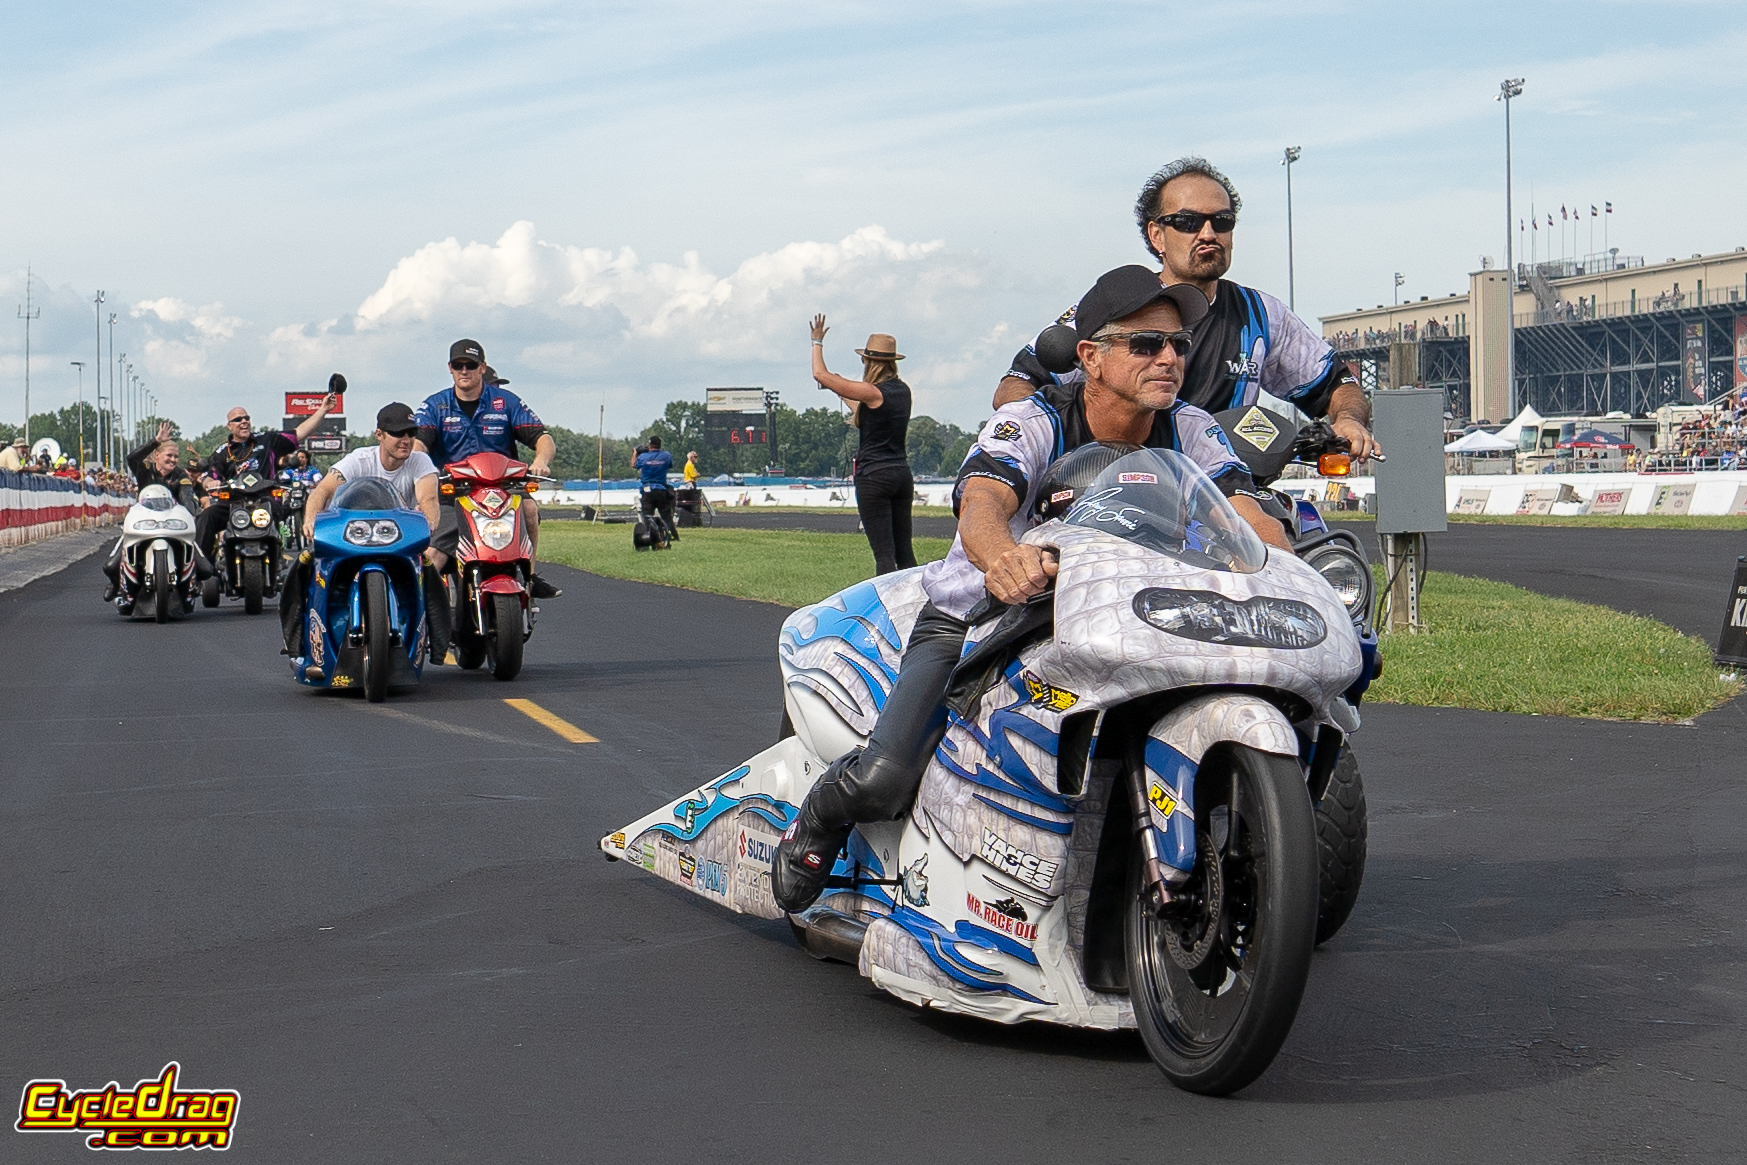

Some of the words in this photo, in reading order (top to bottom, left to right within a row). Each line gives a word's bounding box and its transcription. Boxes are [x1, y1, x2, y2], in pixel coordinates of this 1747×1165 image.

[1225, 358, 1259, 375] WAR
[1149, 784, 1177, 817] PJ1
[980, 842, 1053, 890] HINES
[983, 826, 1059, 878] VANCE
[966, 891, 983, 917] MR.
[984, 905, 1013, 933] RACE
[1014, 919, 1038, 940] OIL
